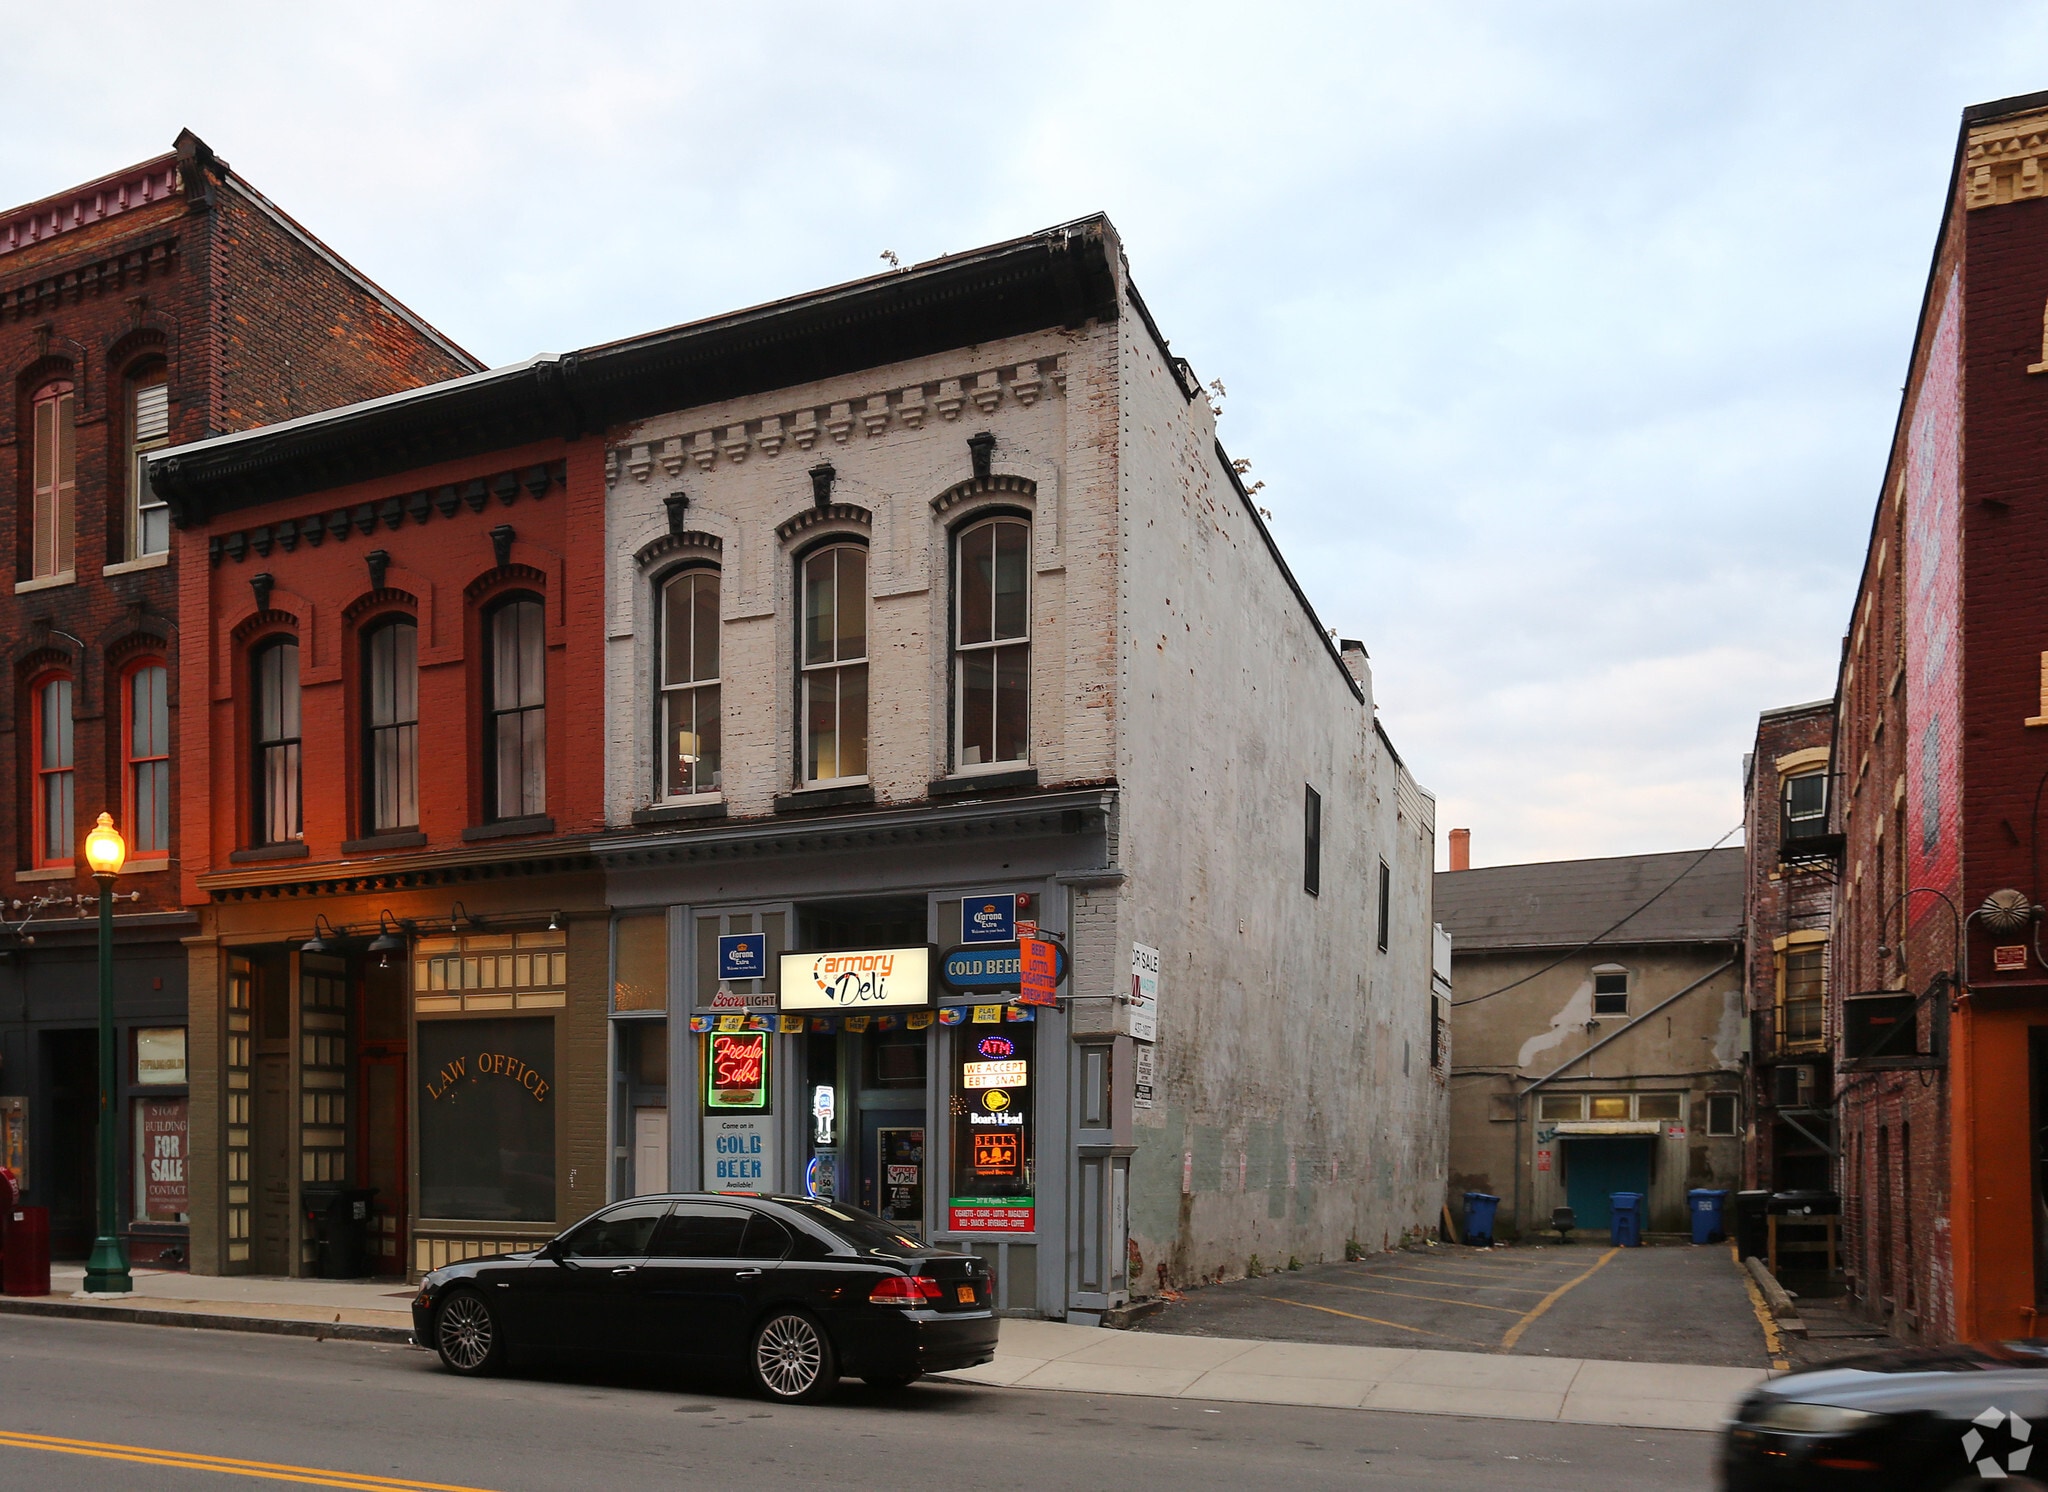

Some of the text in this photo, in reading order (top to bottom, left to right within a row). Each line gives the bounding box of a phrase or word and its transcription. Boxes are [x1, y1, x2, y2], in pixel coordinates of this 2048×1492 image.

[974, 912, 1002, 922] Corona
[728, 950, 754, 960] Corona
[1031, 943, 1046, 957] BEER
[824, 954, 894, 976] armory
[948, 959, 1021, 976] COLD BEER
[1029, 959, 1048, 974] LOTTO
[1141, 952, 1158, 973] SALE
[836, 972, 888, 1006] Deli
[713, 992, 774, 1008] Coors LIGHT
[714, 1036, 764, 1063] Fresh
[982, 1040, 1011, 1055] ATM
[716, 1059, 759, 1084] Subs
[966, 1062, 1024, 1073] WE ACCEPT
[426, 1052, 550, 1102] LAW OFFICE
[968, 1075, 1022, 1086] EBT SNAP
[970, 1112, 1022, 1124] Boar's Head
[145, 1121, 187, 1131] BUILDING
[154, 1135, 179, 1158] FOR
[716, 1132, 762, 1154] COLD
[975, 1136, 1017, 1145] BELL'S
[151, 1159, 183, 1181] SALE
[716, 1157, 762, 1178] BEER
[896, 1172, 915, 1184] Deli
[150, 1185, 186, 1195] CONTACT
[890, 1187, 898, 1198] 7
[988, 1219, 1008, 1227] BEVERAGES
